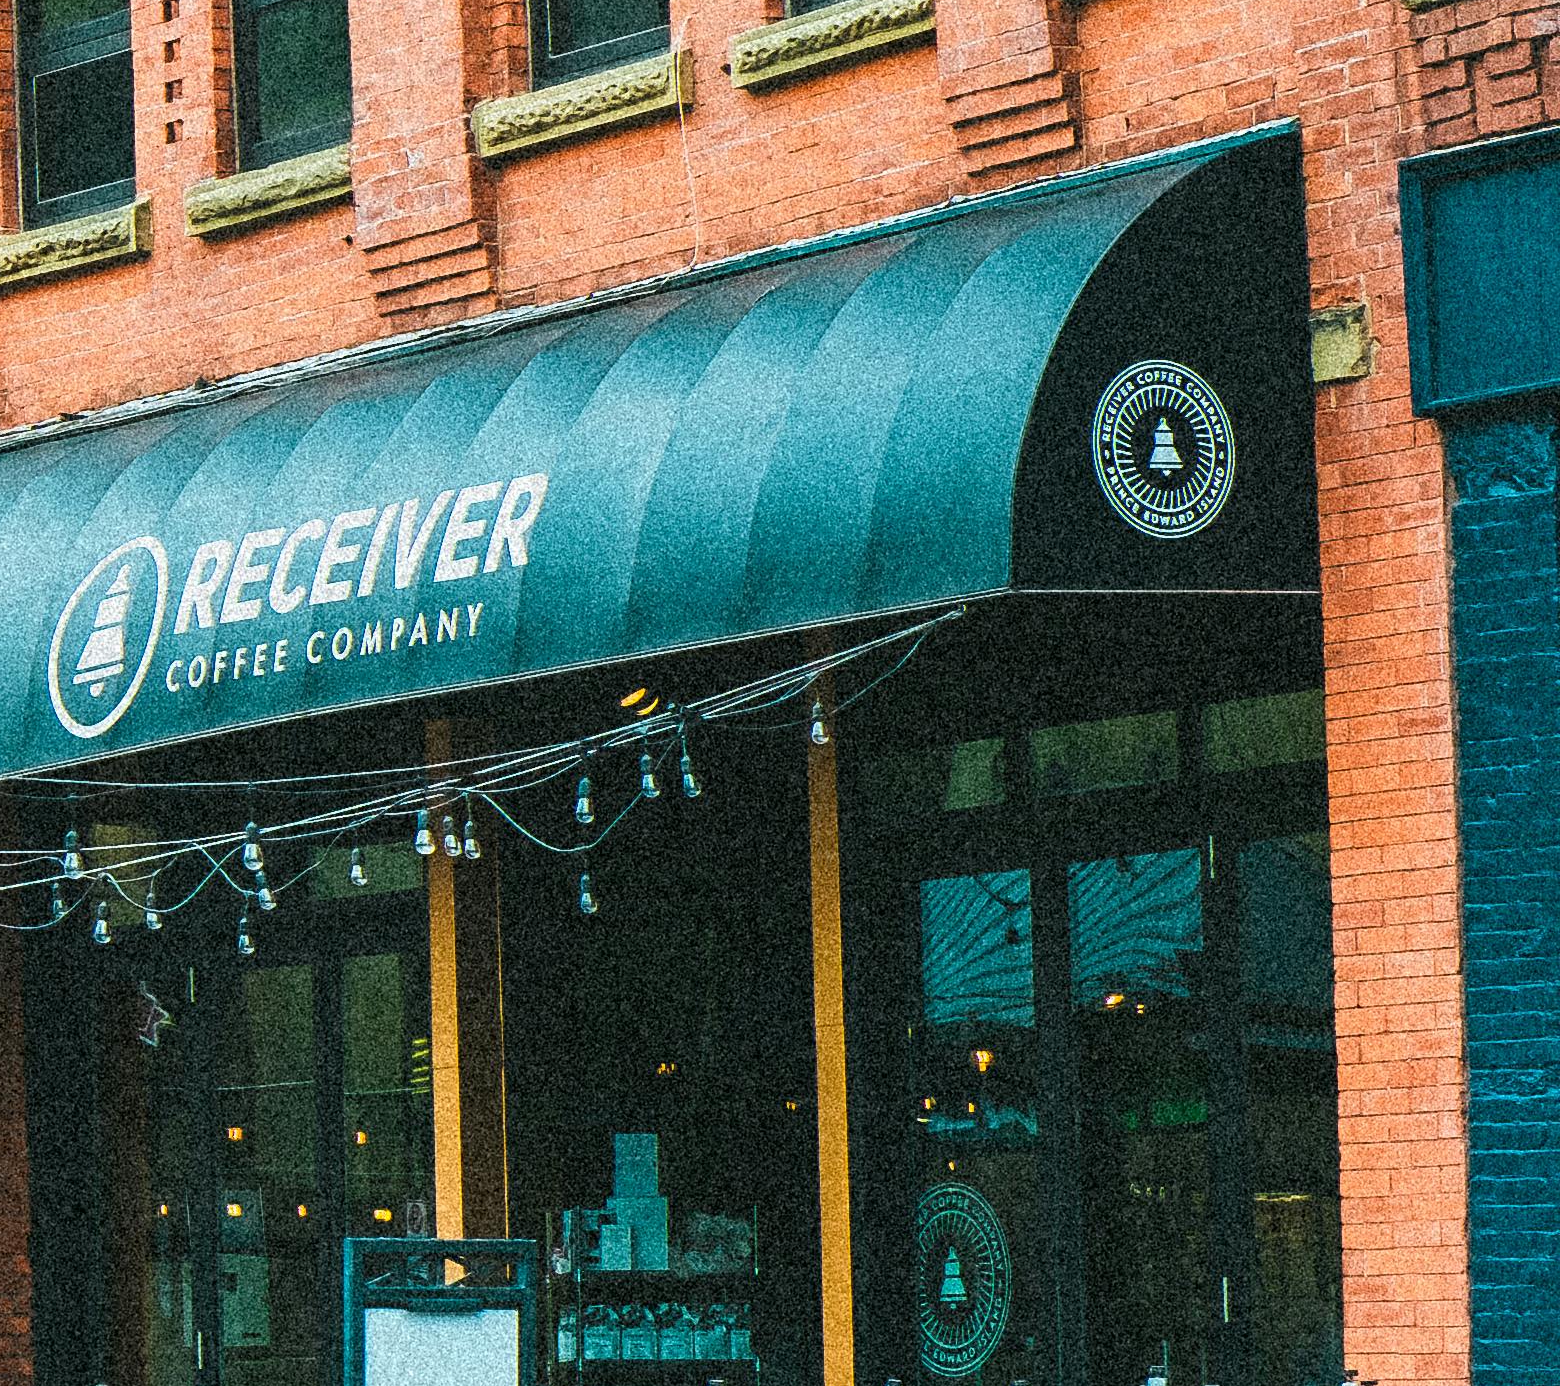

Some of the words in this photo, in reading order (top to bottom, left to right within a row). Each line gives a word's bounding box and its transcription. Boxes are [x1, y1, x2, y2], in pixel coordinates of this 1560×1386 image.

[1102, 381, 1135, 442] RECEIVER
[1136, 371, 1182, 386] COFFEE
[1186, 382, 1225, 443] COMPANY
[1107, 467, 1140, 513] PRINCE
[1144, 510, 1194, 526] EDWARD
[1197, 467, 1225, 513] ISLAND
[173, 472, 548, 634] RECEIVER
[165, 640, 288, 693] COFFEE
[305, 603, 486, 665] COMPANY
[934, 1348, 975, 1363] EDWARD
